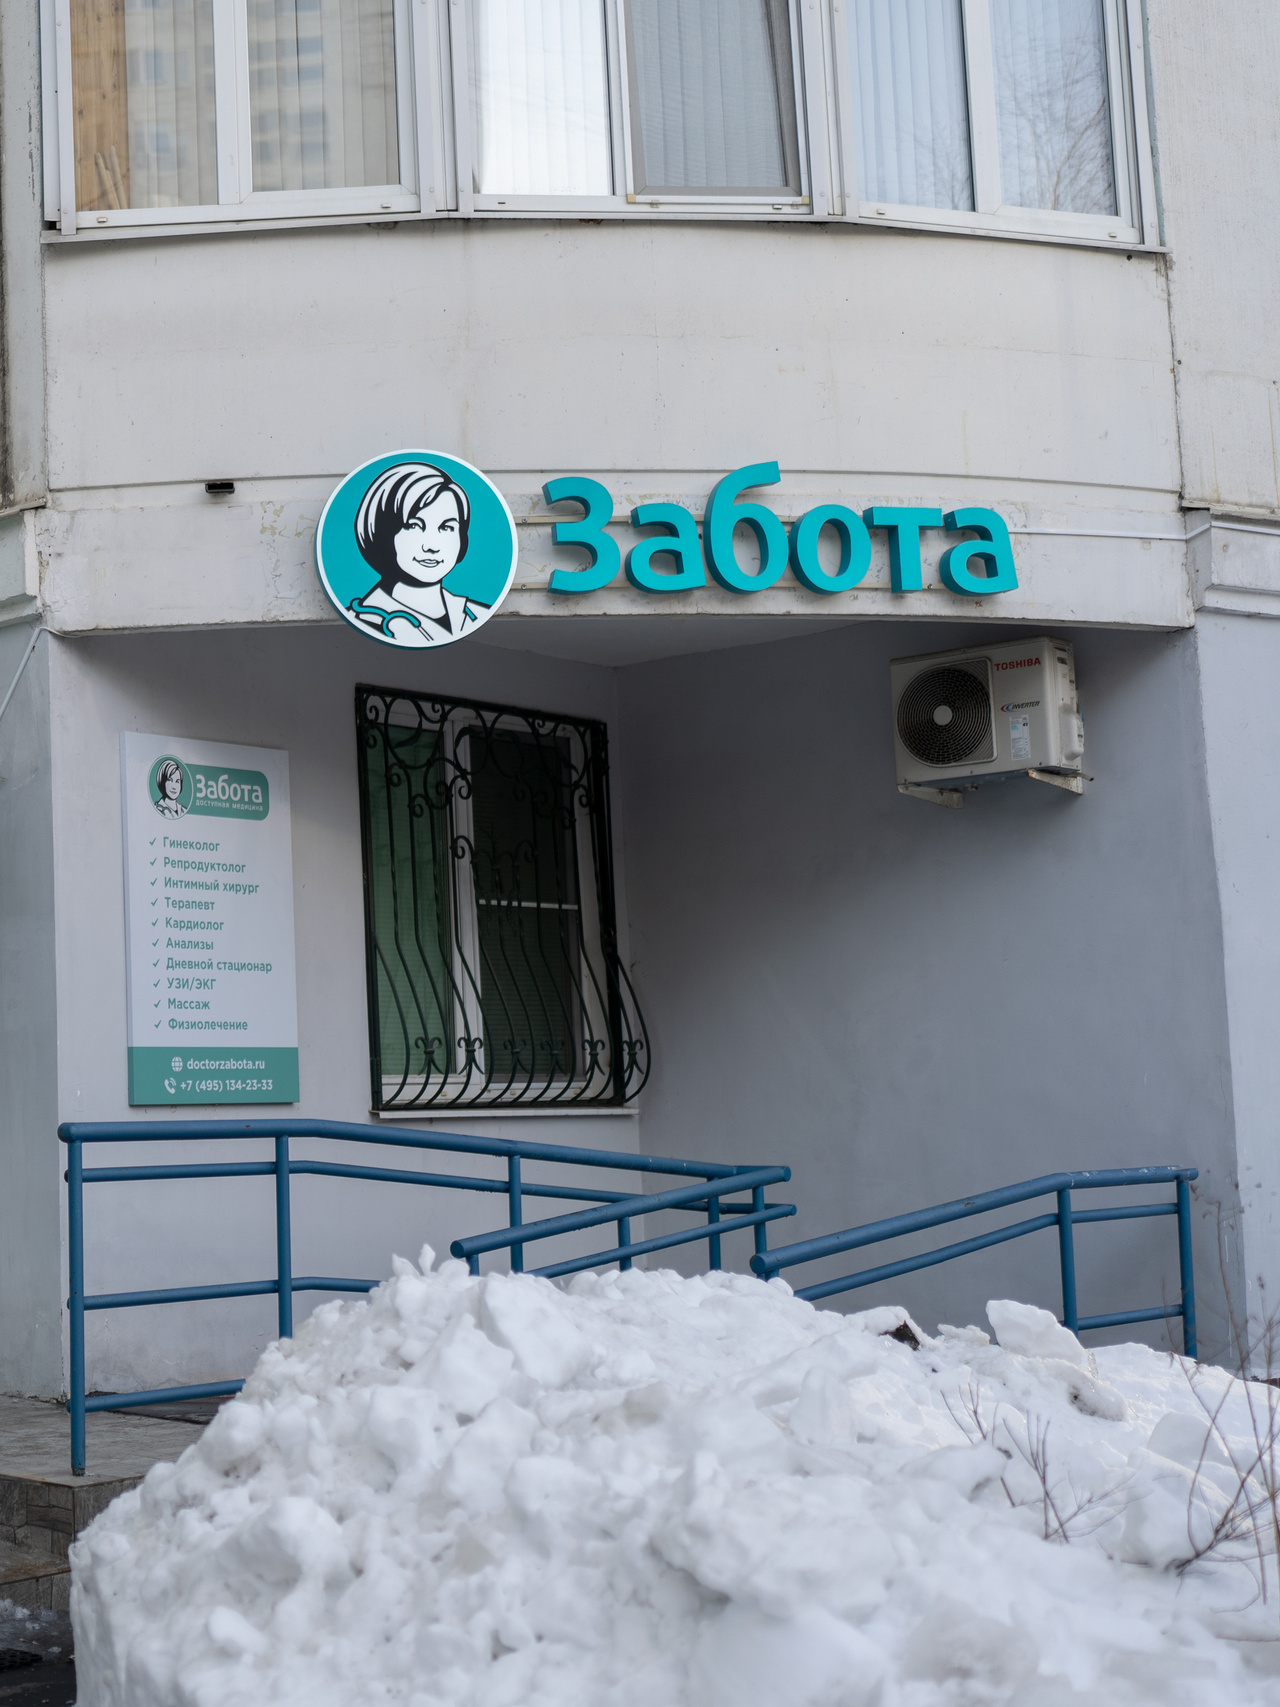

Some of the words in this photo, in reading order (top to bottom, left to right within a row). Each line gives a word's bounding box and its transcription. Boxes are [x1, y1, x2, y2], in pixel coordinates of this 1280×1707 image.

[542, 460, 1019, 596] Забота
[994, 657, 1041, 671] TOSHIBA
[1011, 701, 1041, 711] INVERTER
[195, 774, 263, 803] Забота
[163, 836, 220, 851] Гинеколог
[163, 857, 247, 873] Репродуктолог
[164, 877, 220, 891] Интимный
[222, 882, 260, 895] хирург
[164, 896, 215, 911] Терапевт
[165, 916, 224, 931] Кардиолог
[166, 937, 214, 950] Анализы
[166, 957, 214, 971] Дневной
[216, 961, 273, 974] стационар
[167, 976, 216, 991] УЗИ/ЭКГ
[167, 998, 211, 1010] Массаж
[168, 1018, 248, 1031] Физиолечение
[186, 1058, 265, 1070] doctorzabota.ru
[180, 1080, 193, 1091] +7
[195, 1080, 223, 1093] (495)
[225, 1079, 273, 1091] 134-23-33
